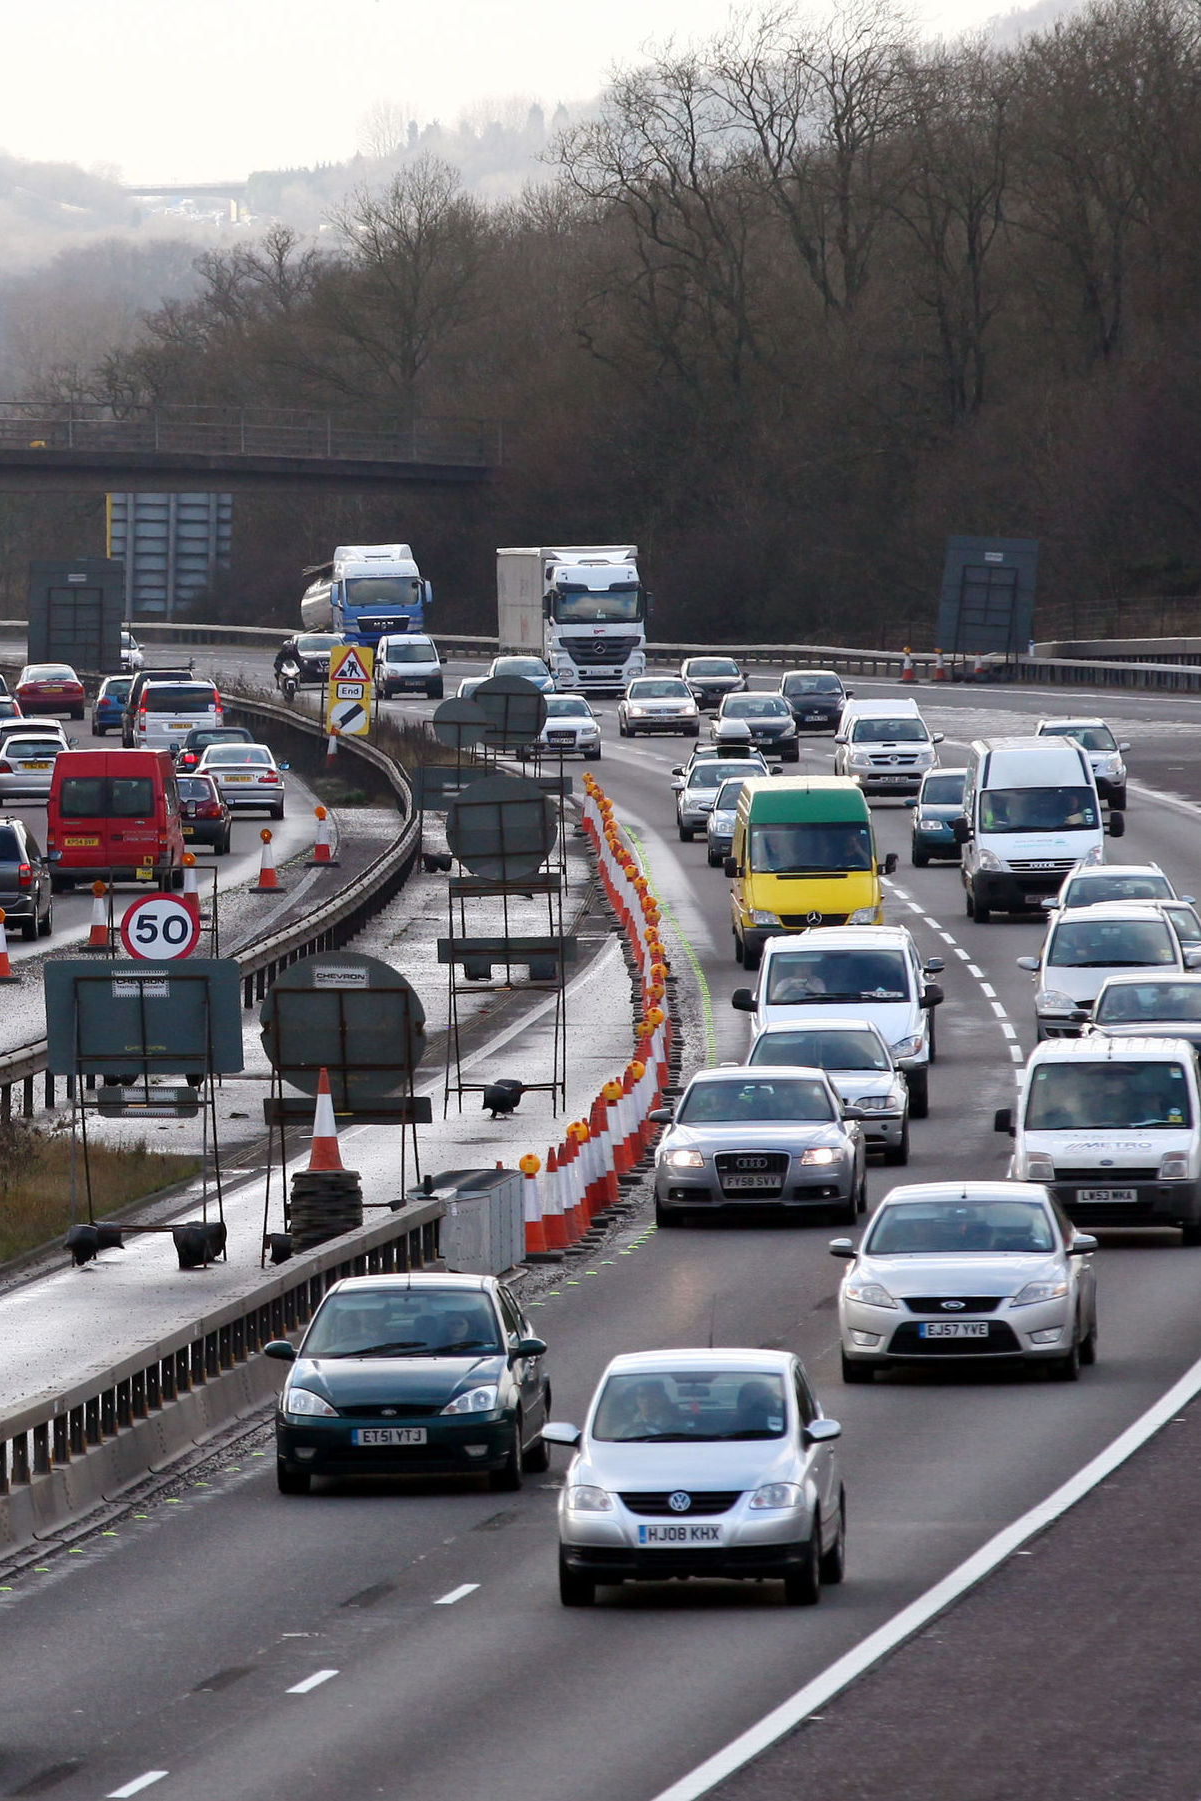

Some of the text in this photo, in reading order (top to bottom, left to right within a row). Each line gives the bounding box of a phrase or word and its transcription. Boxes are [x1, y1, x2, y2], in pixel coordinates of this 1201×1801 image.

[341, 687, 359, 695] End
[135, 914, 189, 945] 50
[757, 1176, 777, 1186] SVV
[928, 1323, 987, 1336] EJ57 YVE
[362, 1428, 422, 1443] ET51 YTJ
[648, 1526, 720, 1541] HJ08 KHX
